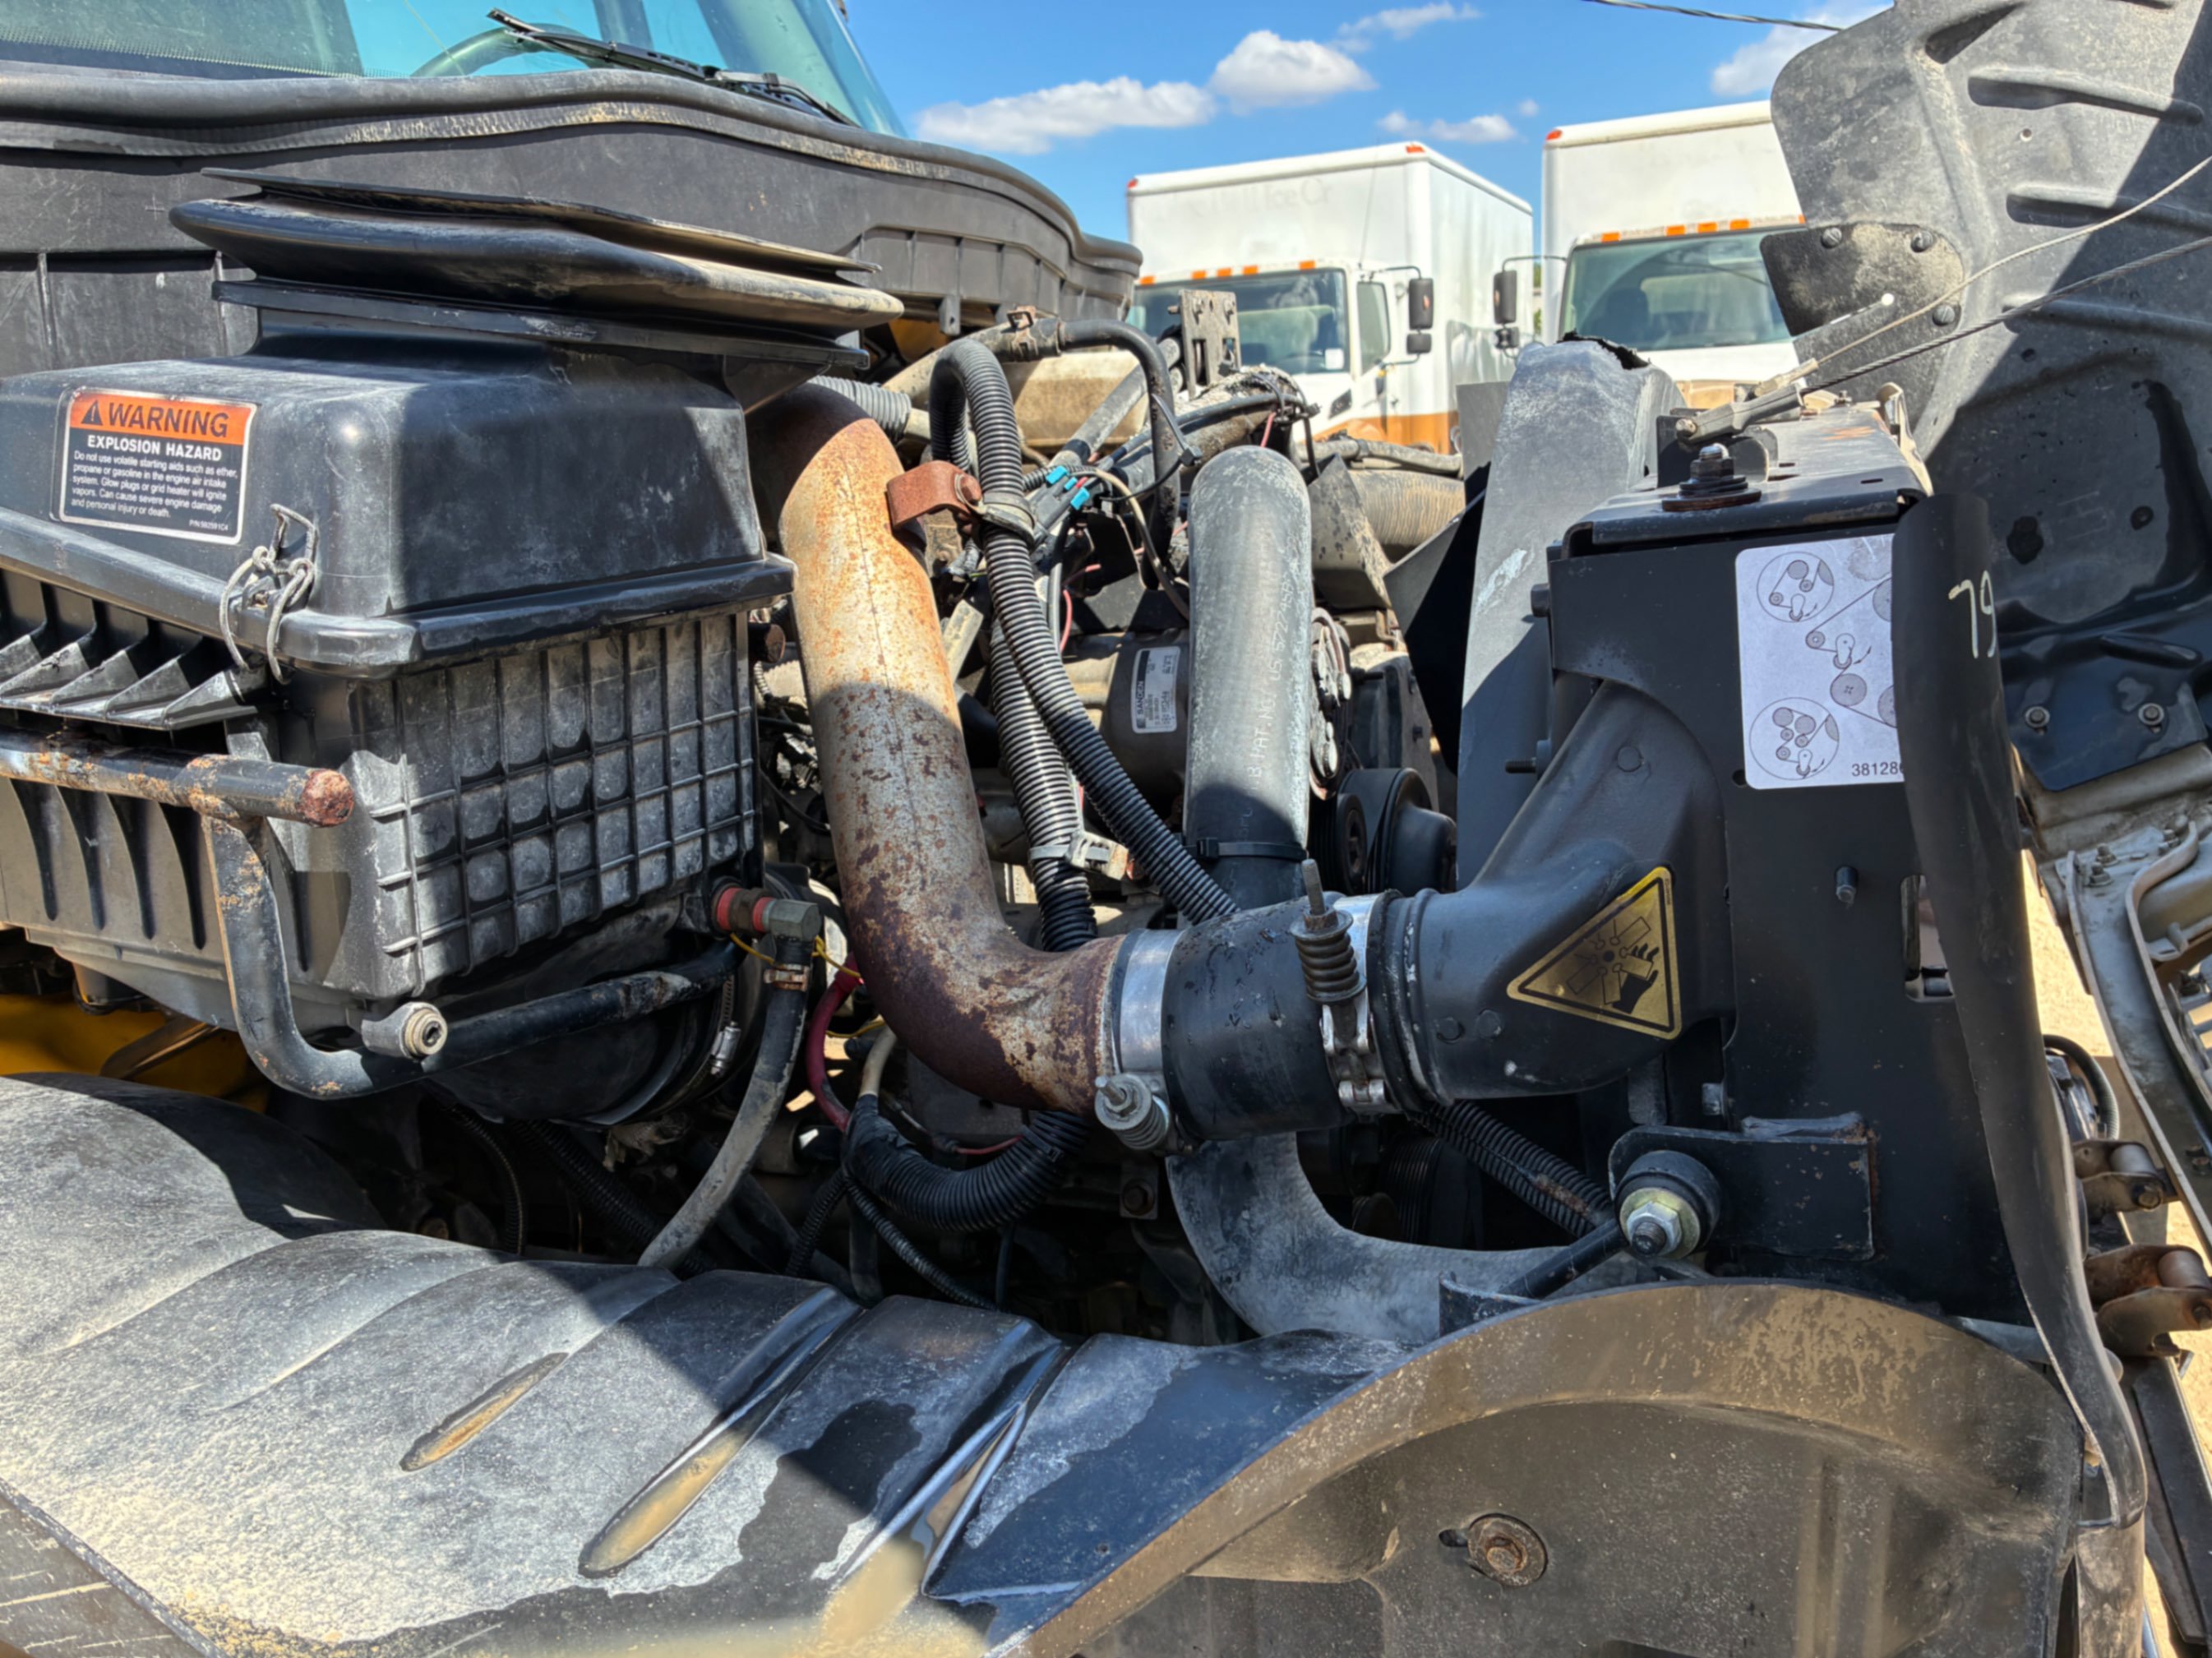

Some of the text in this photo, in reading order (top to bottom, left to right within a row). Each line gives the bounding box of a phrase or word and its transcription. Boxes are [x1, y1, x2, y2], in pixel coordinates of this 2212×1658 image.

[108, 402, 229, 437] WARNING
[87, 435, 222, 461] EXPLOSION HAZARD
[73, 464, 102, 474] propane
[112, 469, 142, 478] gasoline
[144, 470, 150, 479] in
[152, 471, 164, 481] the
[166, 474, 191, 485] engine
[192, 476, 202, 485] air
[203, 477, 226, 488] intake
[74, 450, 85, 460] Do
[86, 453, 97, 462] not
[113, 455, 138, 466] volatile
[140, 457, 167, 471] starting
[169, 461, 184, 471] aids
[186, 464, 204, 473] such
[205, 466, 215, 475] as
[216, 467, 238, 479] ether,
[72, 487, 222, 514] vapors. Can cause severe engine damage
[73, 476, 99, 485] system.
[101, 477, 119, 487] Glow
[120, 480, 140, 492] plugs
[150, 484, 165, 494] grid
[167, 485, 190, 496] heater
[192, 488, 204, 498] will
[205, 490, 227, 501] ignite
[71, 498, 85, 507] and
[85, 501, 115, 510] personal
[118, 503, 138, 516] injury
[148, 506, 171, 518] death.
[1949, 570, 1997, 658] 79
